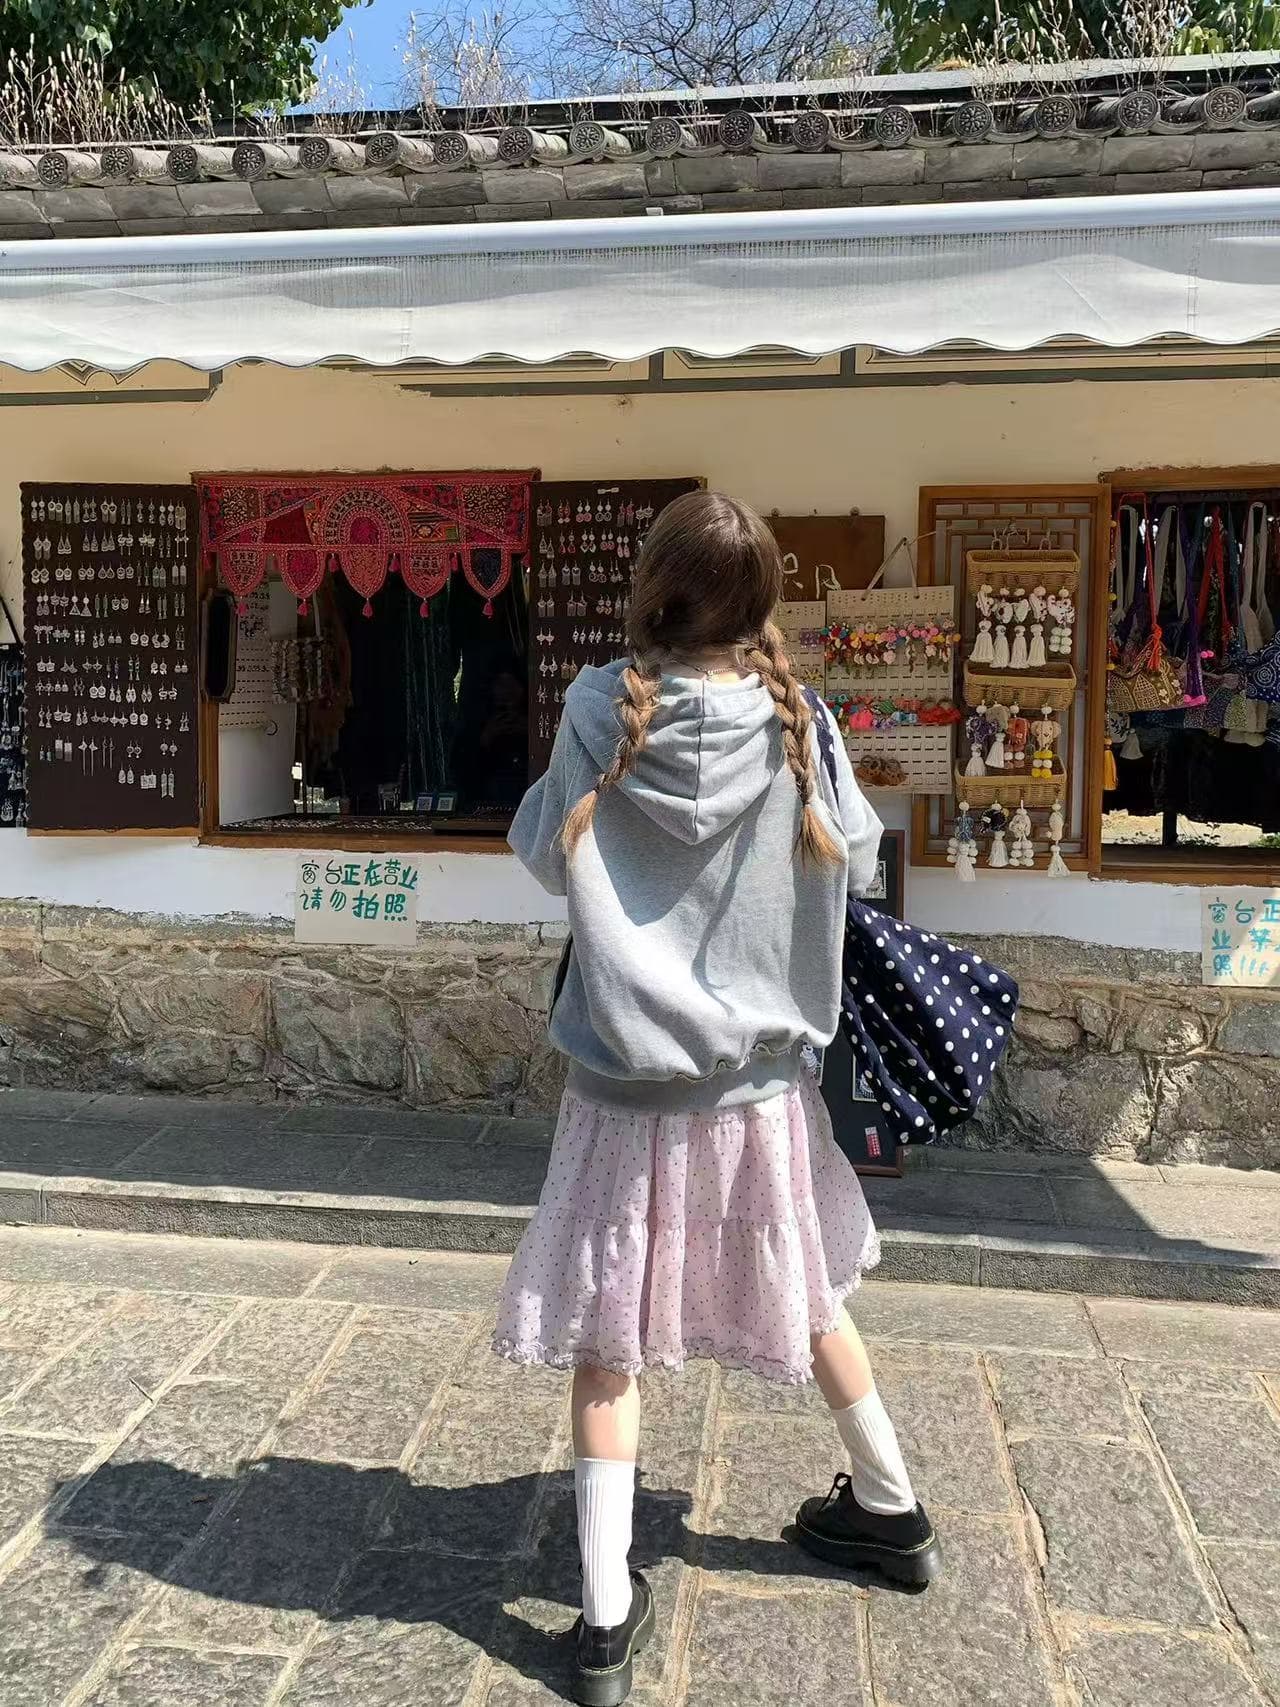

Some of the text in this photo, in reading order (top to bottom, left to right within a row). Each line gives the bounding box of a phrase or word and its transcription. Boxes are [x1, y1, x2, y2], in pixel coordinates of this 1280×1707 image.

[301, 859, 418, 890] 窗台正在营业
[299, 886, 408, 922] 请勿拍照
